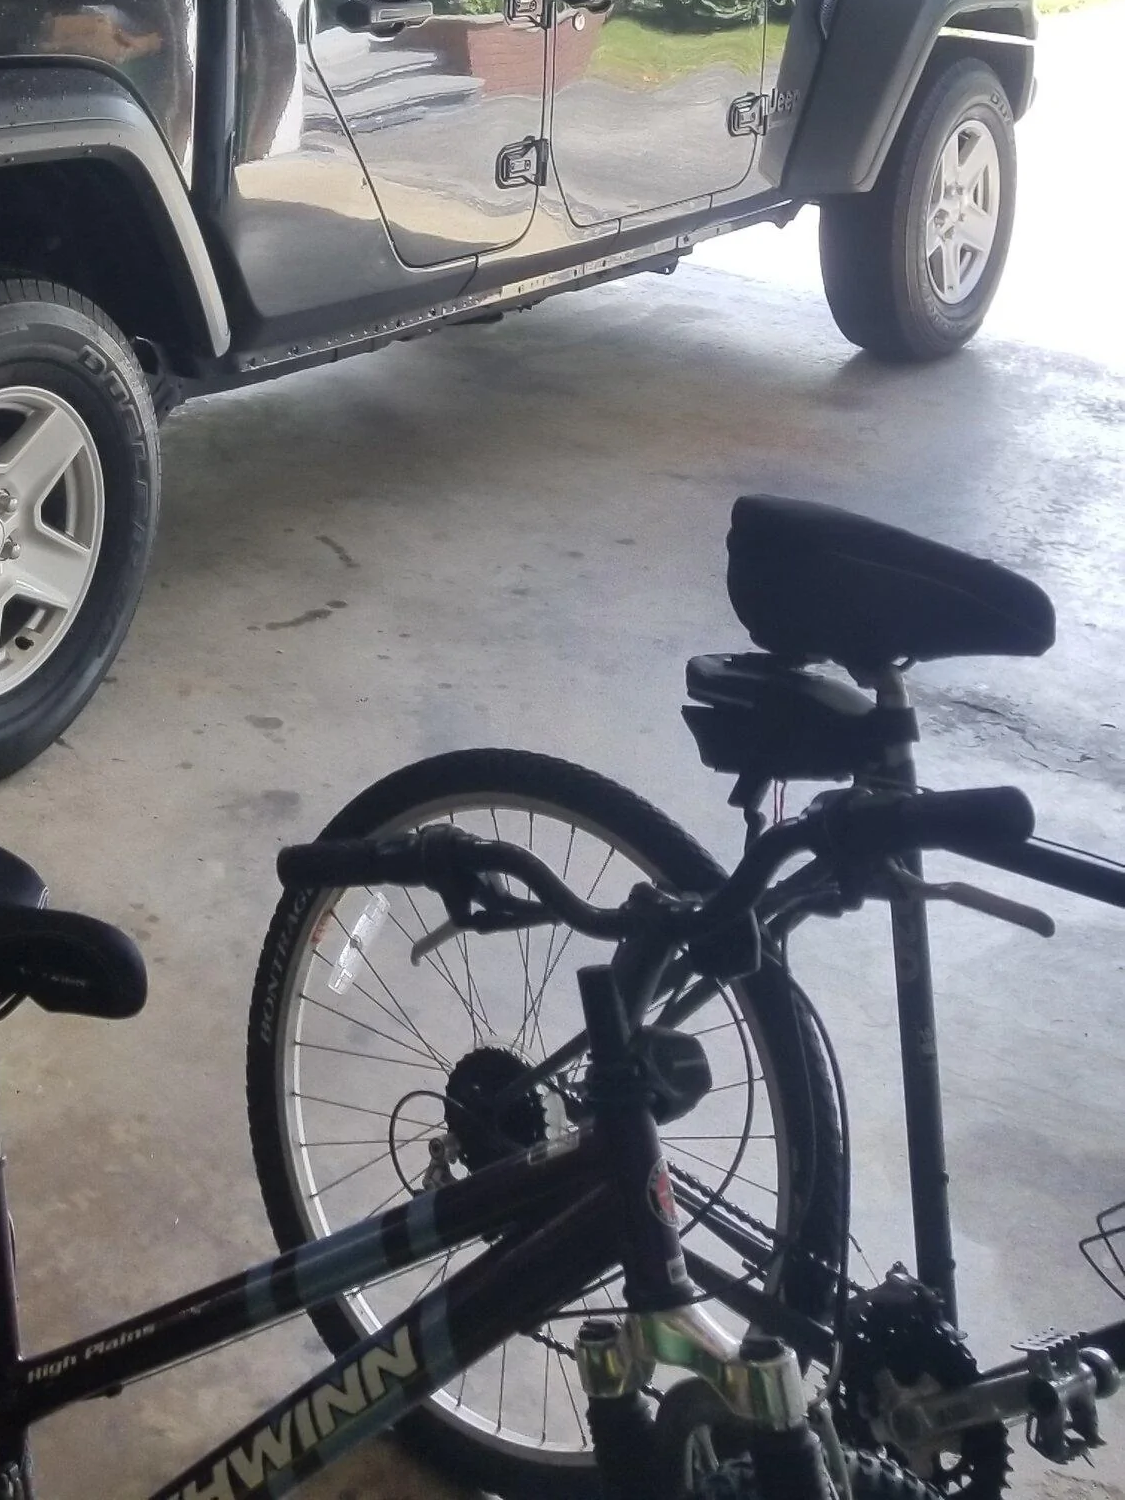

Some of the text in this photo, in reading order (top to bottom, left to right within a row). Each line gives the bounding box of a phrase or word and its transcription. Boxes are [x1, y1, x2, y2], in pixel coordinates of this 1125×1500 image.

[770, 87, 800, 113] Jeep
[261, 888, 313, 1047] BONTRAG
[27, 1322, 156, 1384] High Plains
[167, 1324, 419, 1500] HWINN
